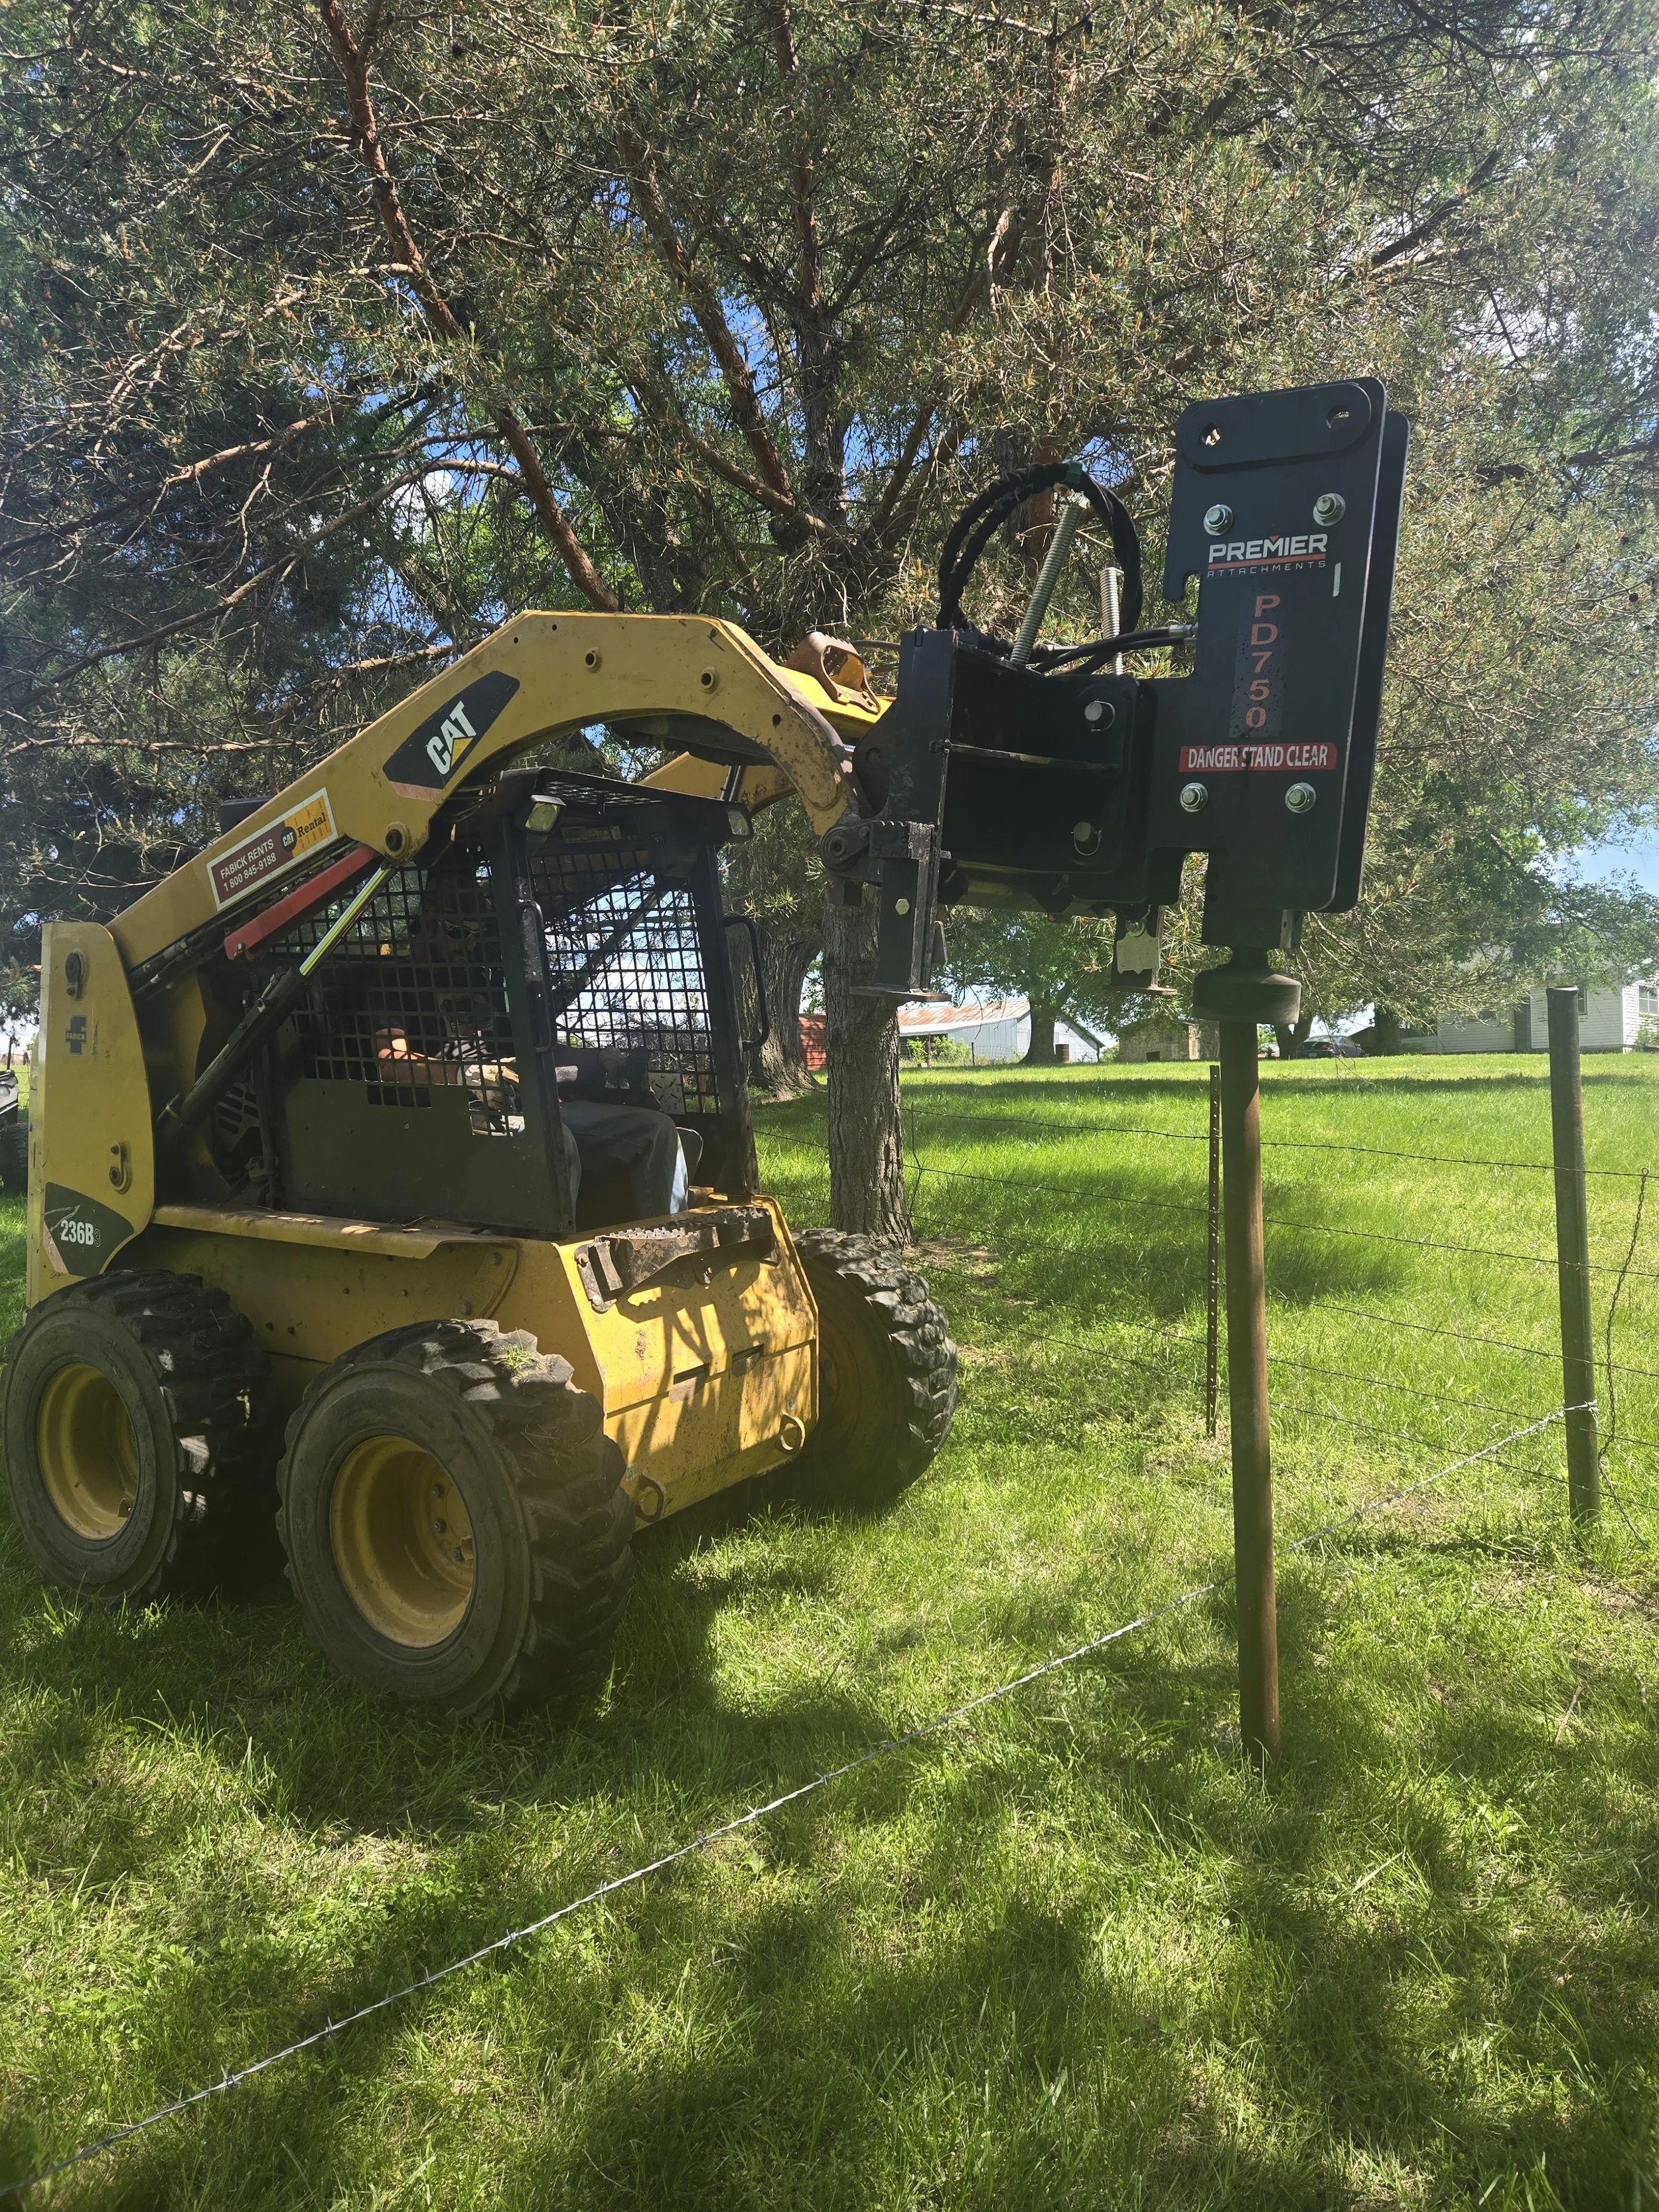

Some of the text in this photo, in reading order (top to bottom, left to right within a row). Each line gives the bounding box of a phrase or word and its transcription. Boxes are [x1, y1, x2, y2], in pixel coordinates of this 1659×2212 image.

[1208, 534, 1328, 563] PREMIER
[1207, 560, 1326, 578] ATTACHMENTS
[426, 700, 477, 774] CAT
[1188, 744, 1328, 769] DANGER STAND CLEAR
[297, 812, 327, 838] Rental
[282, 832, 295, 847] CAT
[220, 839, 274, 880] FABICK RENTS
[223, 852, 277, 892] 1 800 845-9188
